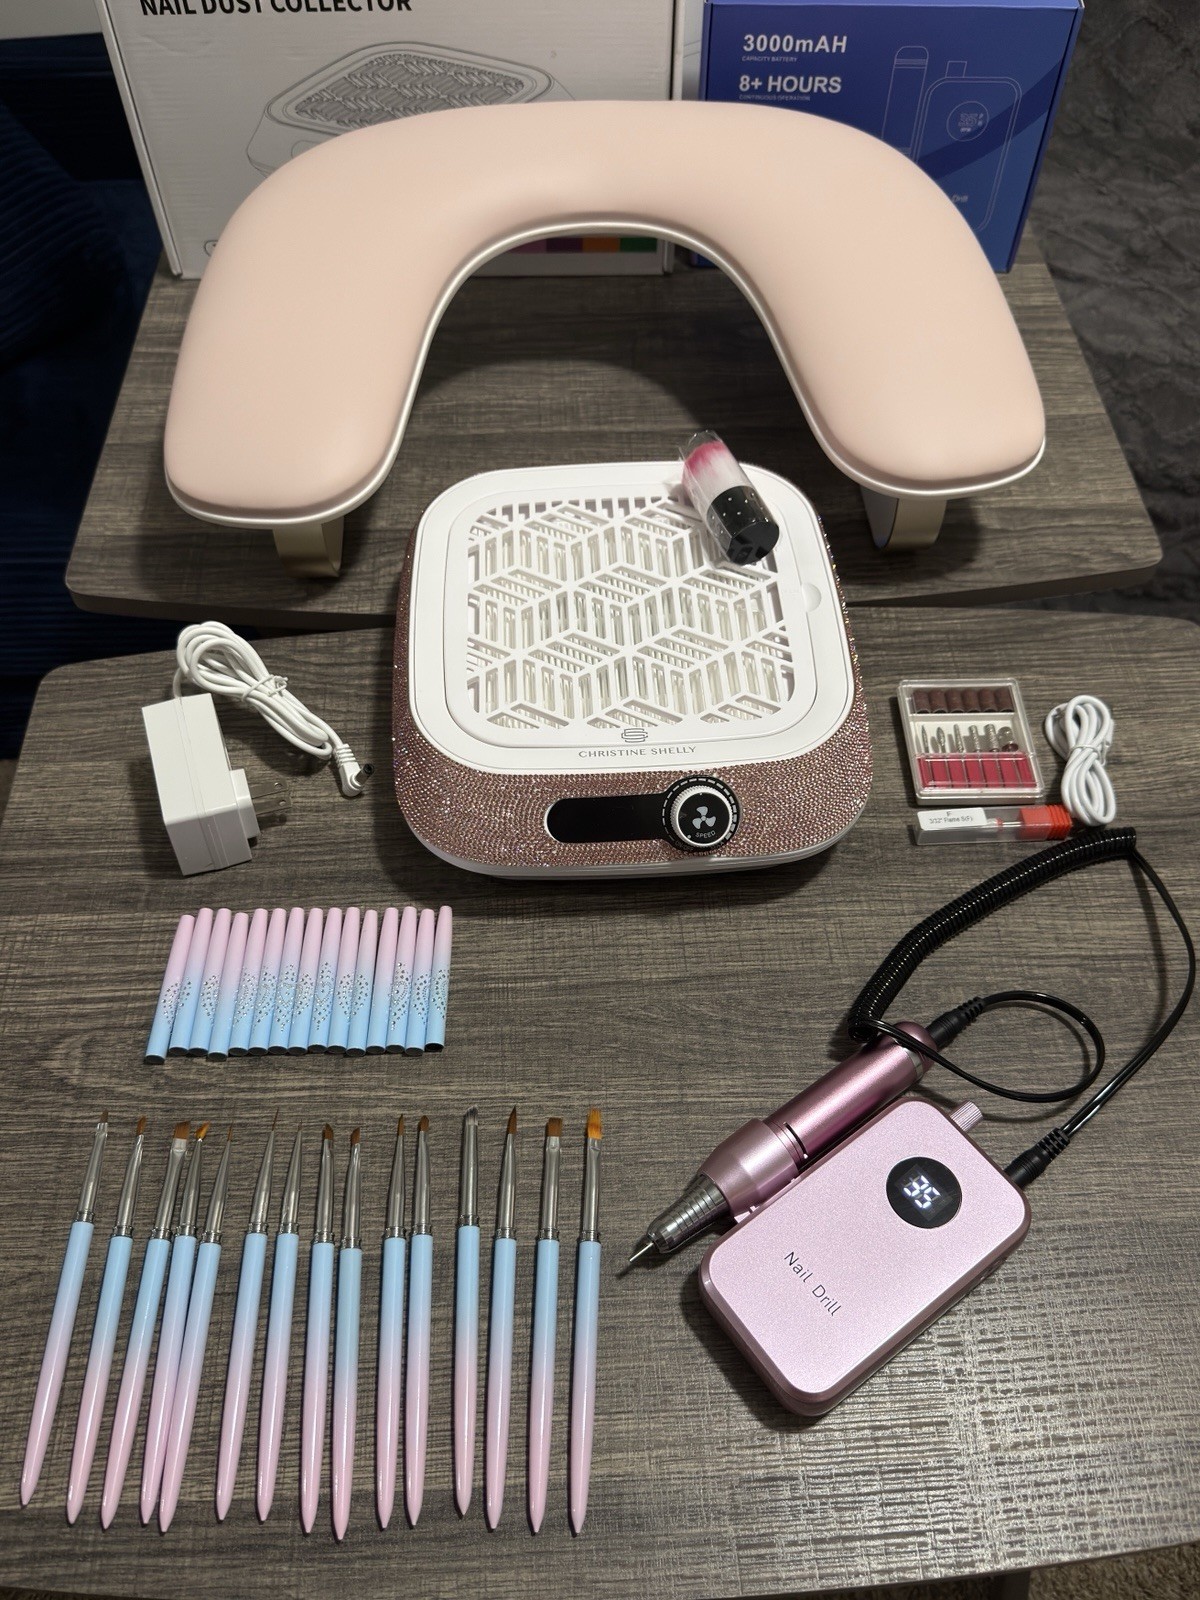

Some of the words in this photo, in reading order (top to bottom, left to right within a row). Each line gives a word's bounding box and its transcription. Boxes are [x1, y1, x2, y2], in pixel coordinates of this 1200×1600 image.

[140, 0, 197, 15] NAIL
[201, 0, 262, 14] DUST
[270, 0, 412, 12] COLLECTOR
[743, 34, 848, 53] 3000mAH
[739, 74, 763, 92] 8+
[767, 75, 842, 93] HOURS
[578, 748, 646, 758] CHRISTINE
[650, 746, 697, 755] SHELLY
[695, 830, 716, 839] SPEED
[783, 1251, 813, 1283] Nail
[811, 1284, 842, 1316] Drill
